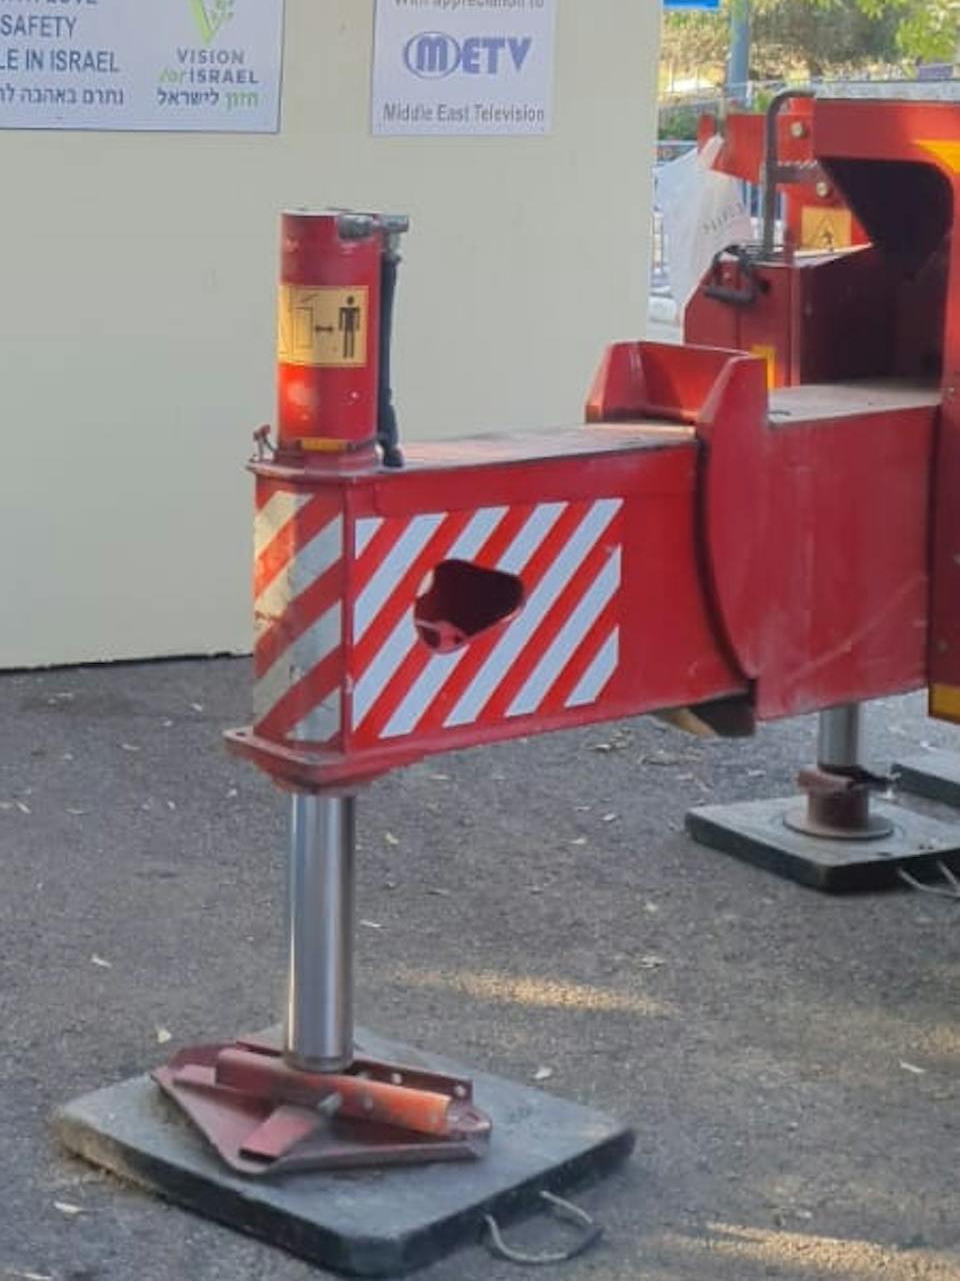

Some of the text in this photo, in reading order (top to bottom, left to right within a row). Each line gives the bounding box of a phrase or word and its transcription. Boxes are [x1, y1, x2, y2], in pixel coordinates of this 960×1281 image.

[0, 14, 78, 39] SAFETY
[25, 49, 44, 71] IN
[50, 49, 121, 74] ISRAEL
[176, 48, 245, 65] VISION
[20, 86, 77, 104] באהבה
[82, 86, 124, 105] נתרם
[156, 85, 220, 107] לישראל
[383, 102, 545, 123] Middle East Television
